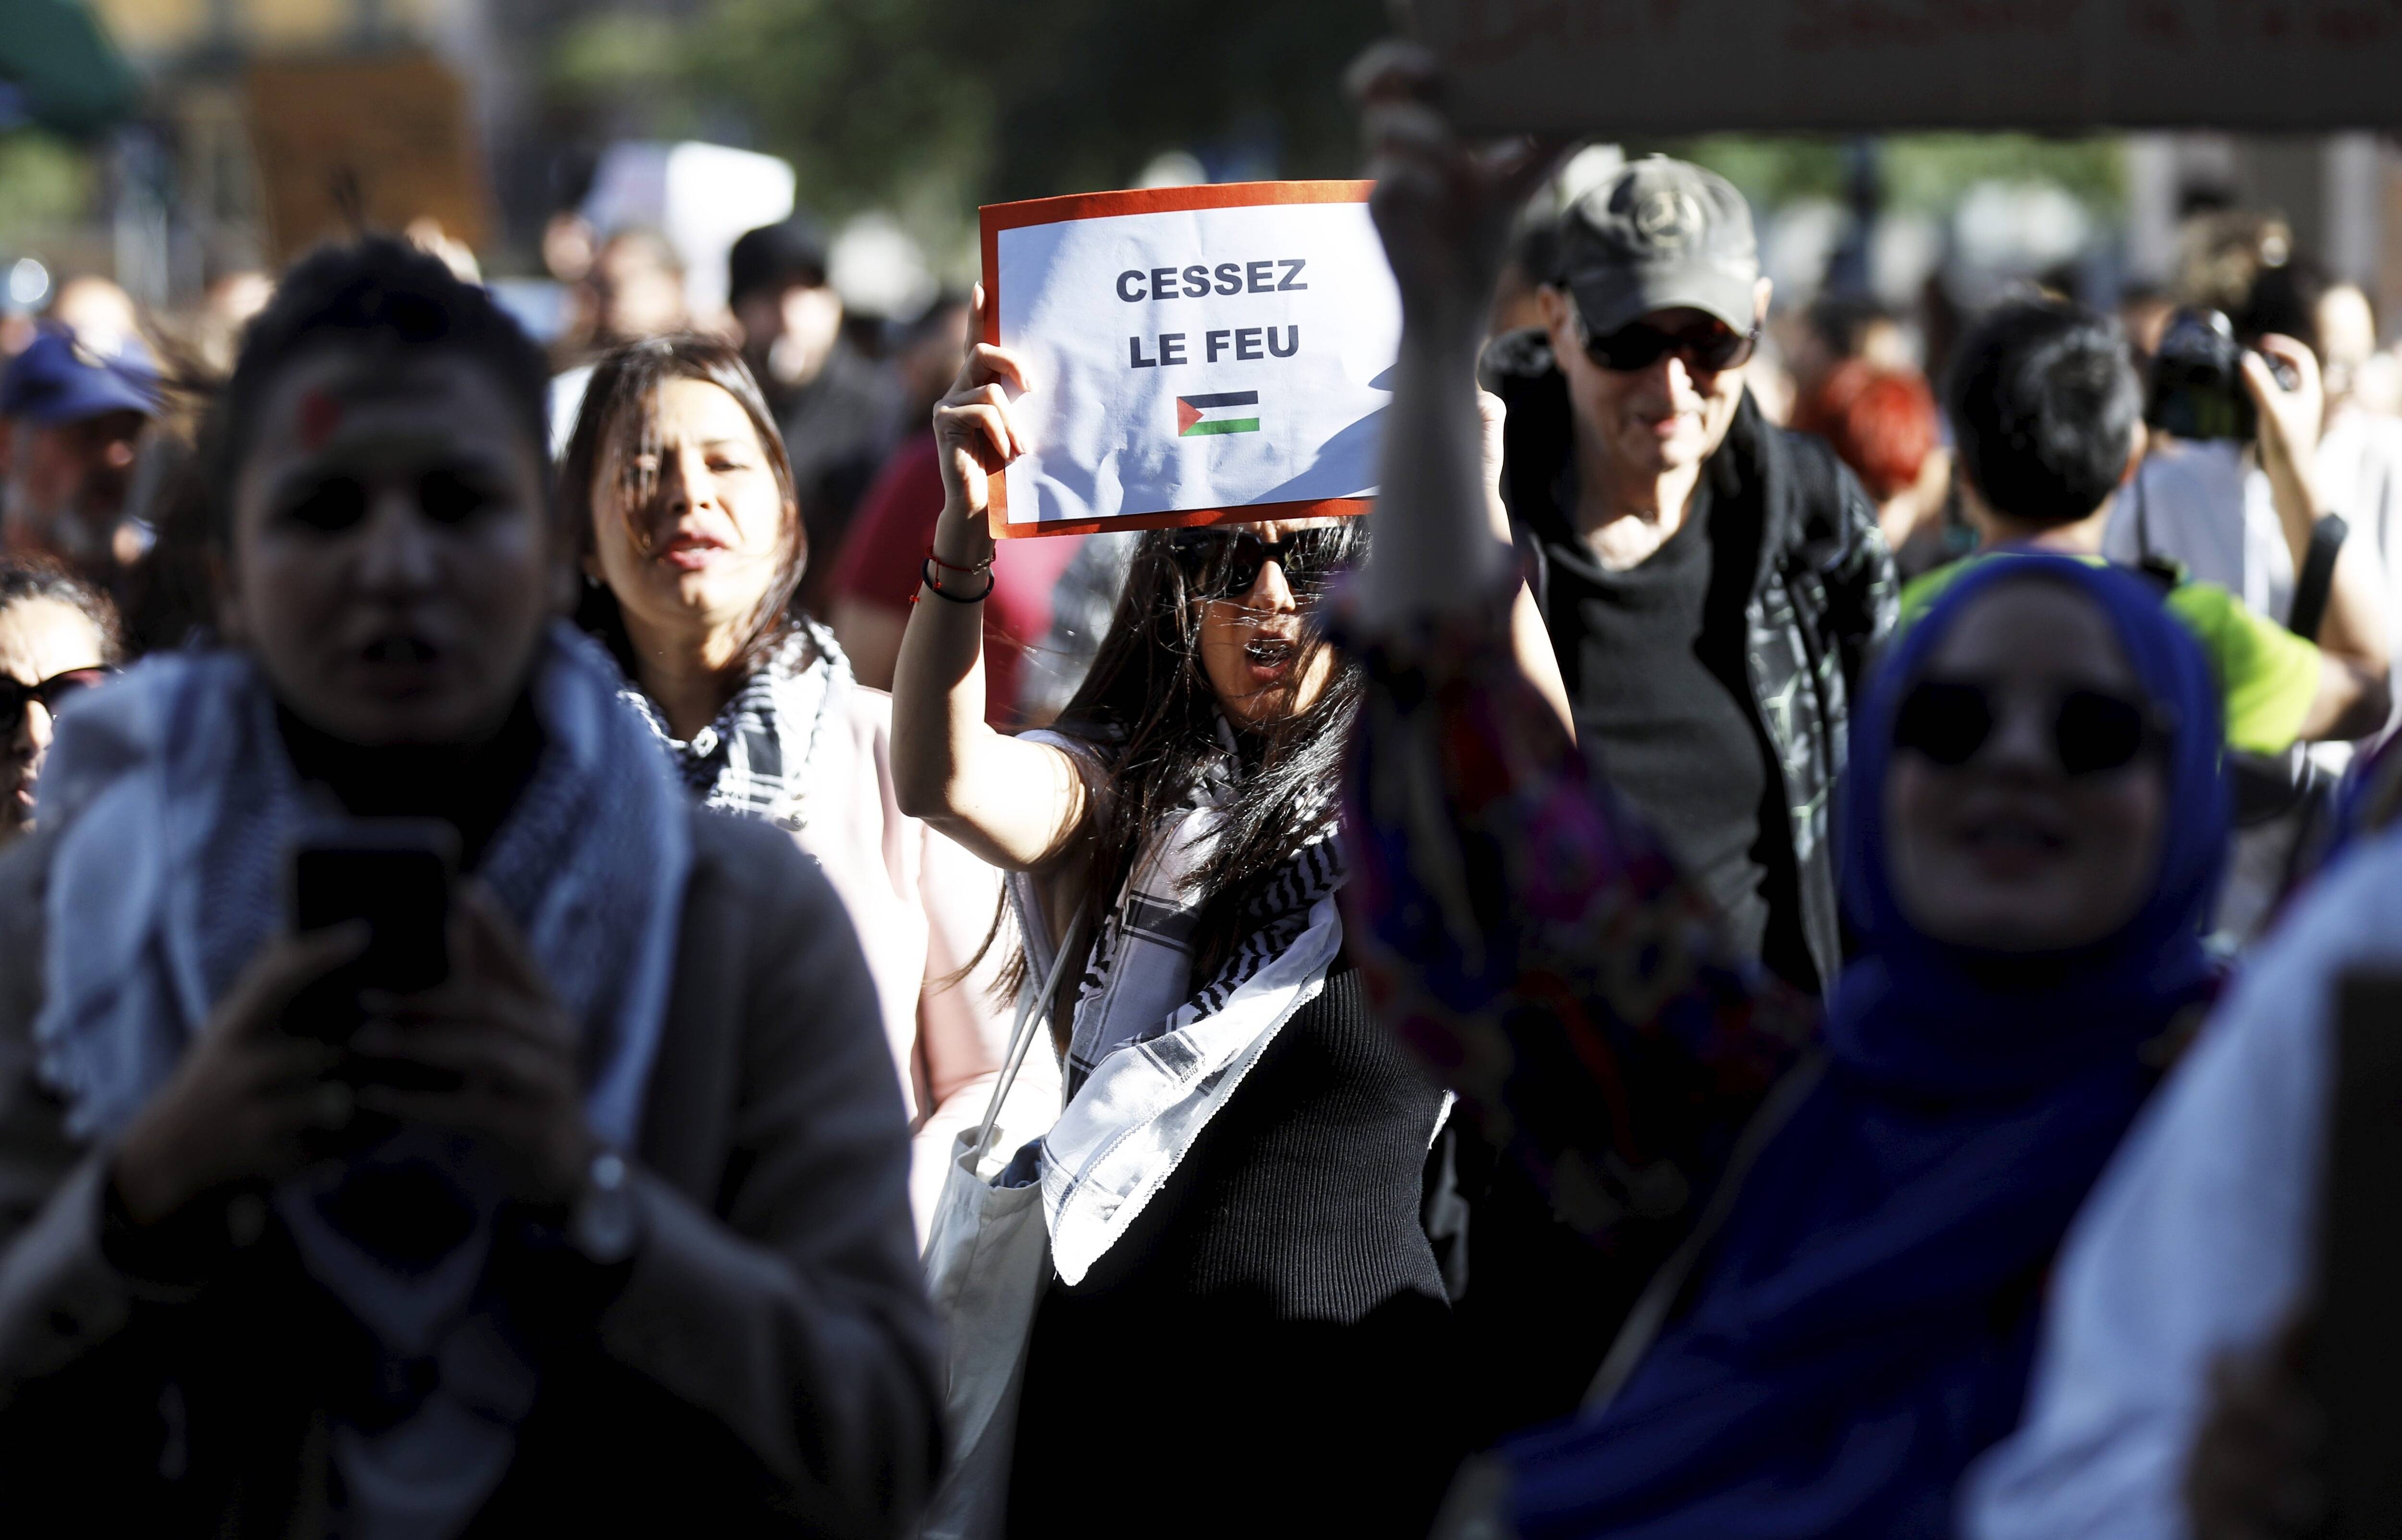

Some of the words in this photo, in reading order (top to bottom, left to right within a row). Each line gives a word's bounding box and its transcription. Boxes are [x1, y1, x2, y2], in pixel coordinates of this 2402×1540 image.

[1116, 258, 1308, 303] CESSEZ
[1129, 333, 1188, 368] LE
[1205, 325, 1299, 363] FEU
